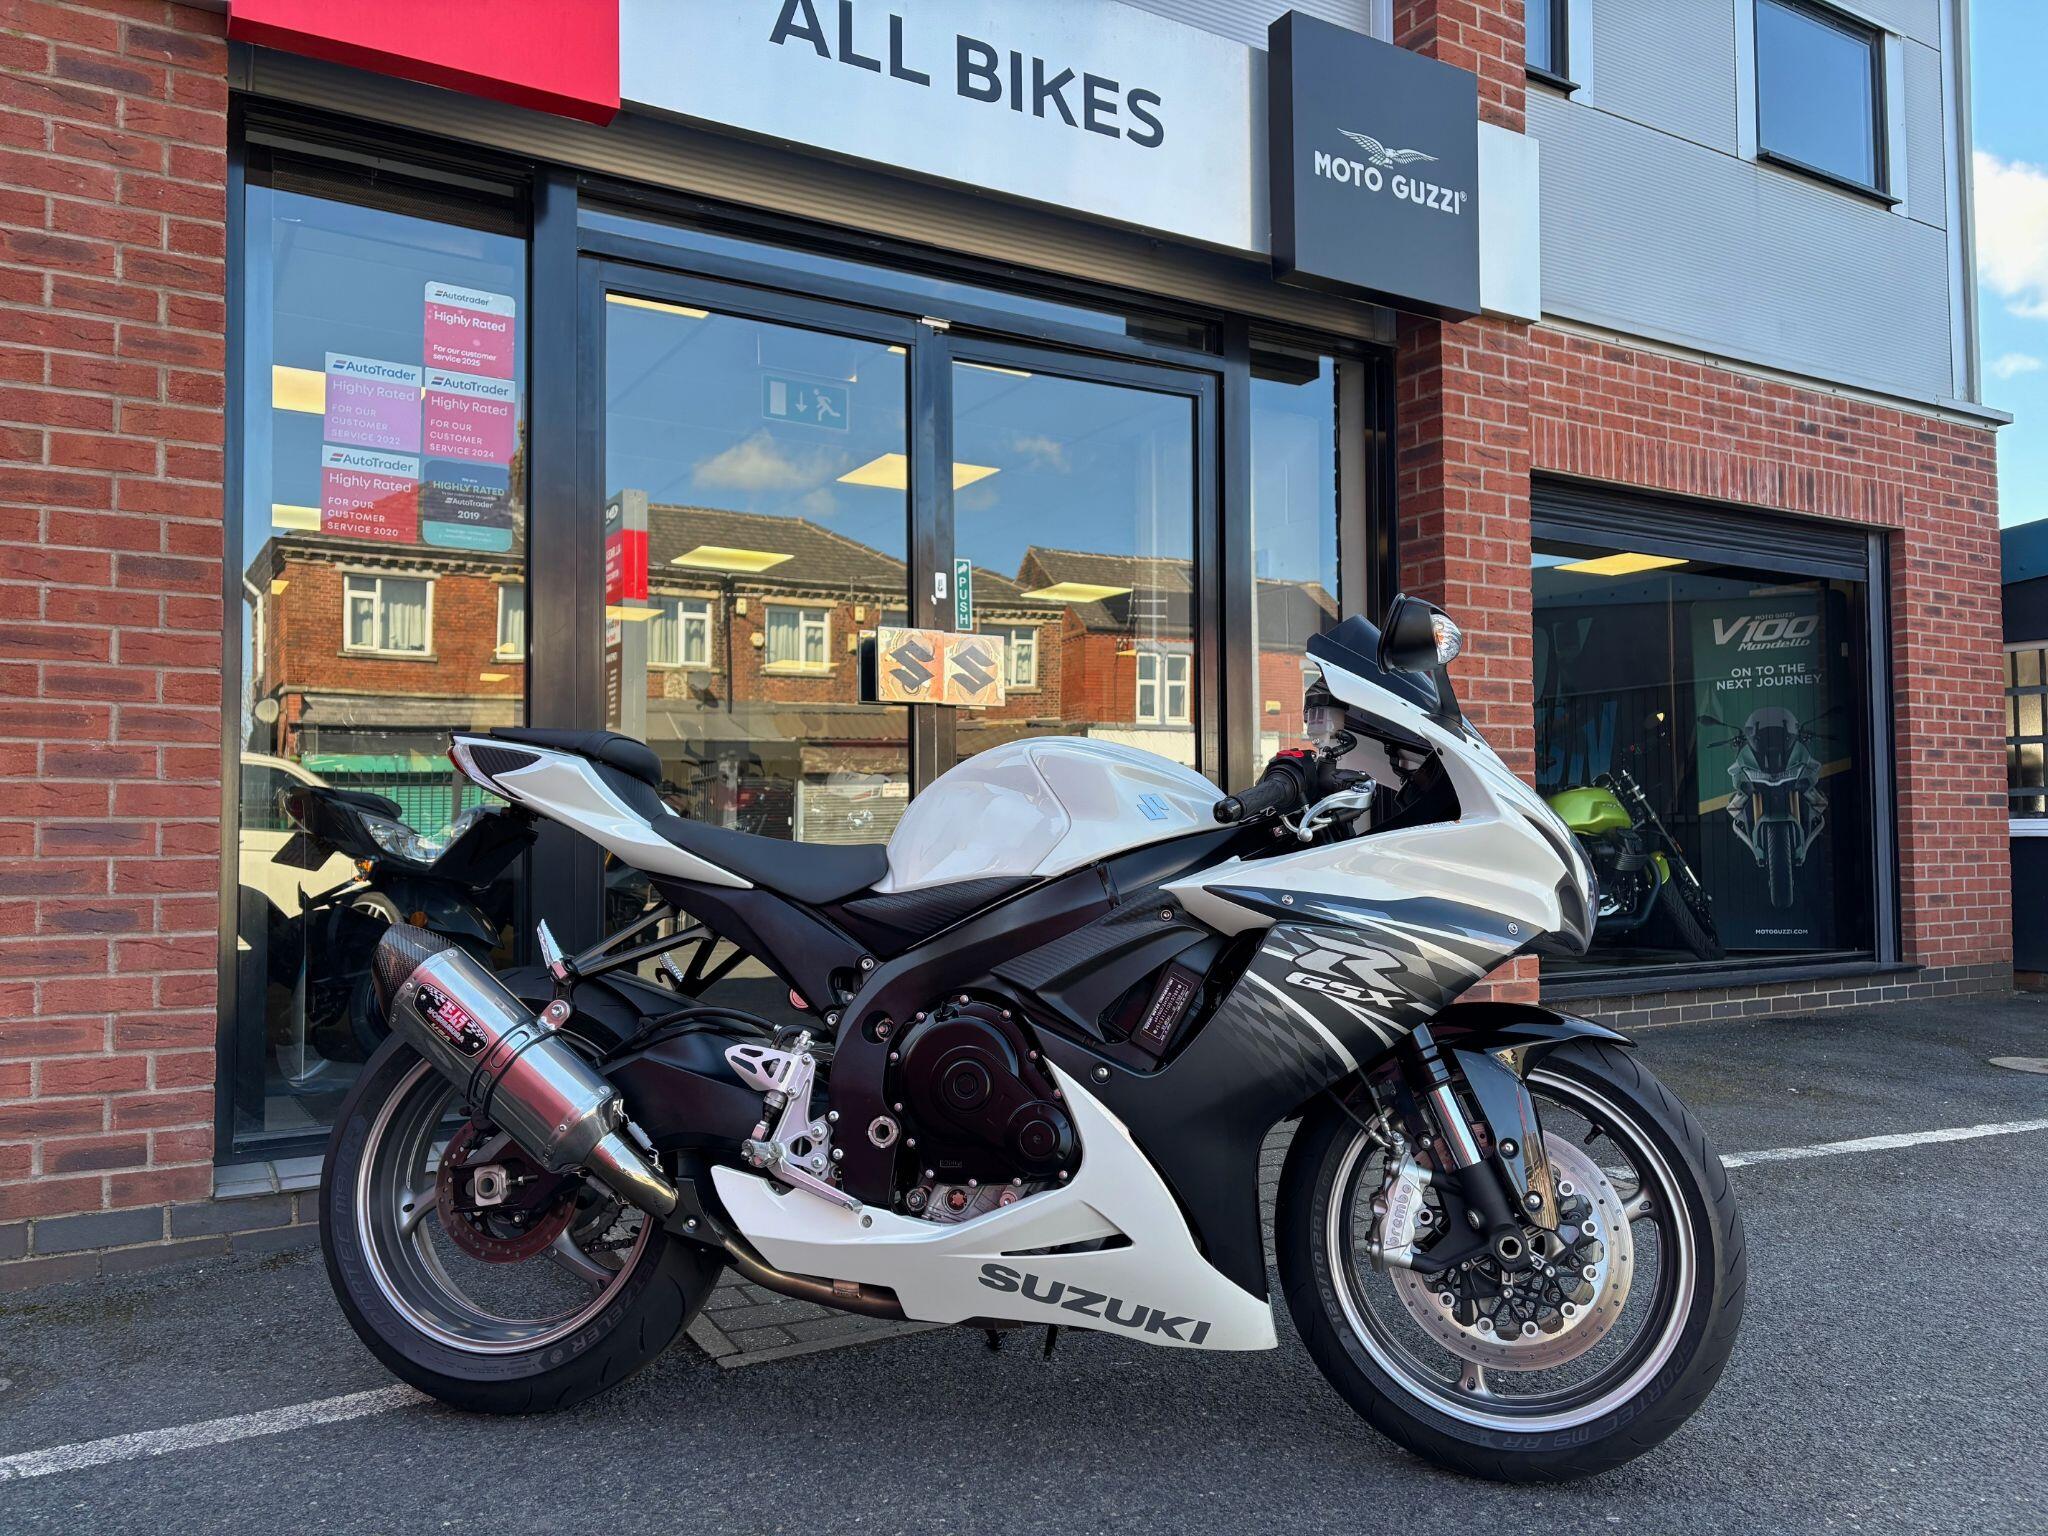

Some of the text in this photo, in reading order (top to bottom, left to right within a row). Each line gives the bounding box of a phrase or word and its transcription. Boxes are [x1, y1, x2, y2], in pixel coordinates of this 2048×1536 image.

[769, 0, 1164, 148] ALL BIKES
[1314, 150, 1383, 192] MOTO
[442, 291, 489, 306] Autotrader
[434, 311, 506, 332] Highly Rated
[433, 344, 446, 353] For
[461, 349, 497, 361] customer
[433, 353, 480, 366] service 2025
[346, 362, 416, 381] AutoTrader
[333, 380, 415, 401] Highly Rated
[443, 378, 509, 396] AutoTrader
[332, 404, 376, 417] FOR OUR
[431, 396, 507, 416] Highly Rated
[331, 416, 388, 431] CUSTOMER
[430, 419, 472, 431] FOR OUR
[331, 429, 374, 441] SERVICE
[430, 431, 482, 445] CUSTOMER
[430, 443, 494, 458] SERVICE 2024
[343, 454, 413, 472] AutoTrader
[329, 473, 411, 492] Highly Rated
[433, 481, 470, 493] HIGHLY
[473, 485, 505, 496] RATED
[328, 496, 374, 509] FOR OUR
[452, 498, 493, 508] AutoTrader
[328, 509, 385, 523] CUSTOMER
[457, 511, 480, 520] 2019
[327, 521, 399, 536] SERVICE 2020
[959, 577, 968, 625] PUSH
[1713, 615, 1819, 645] V100
[1738, 638, 1810, 652] Mandello
[1731, 663, 1806, 678] ON TO THE
[1716, 674, 1822, 691] NEXT JOURNEY
[1285, 972, 1406, 1009] GSX
[1386, 1184, 1411, 1246] brembo
[978, 1263, 1211, 1345] SUZUKI
